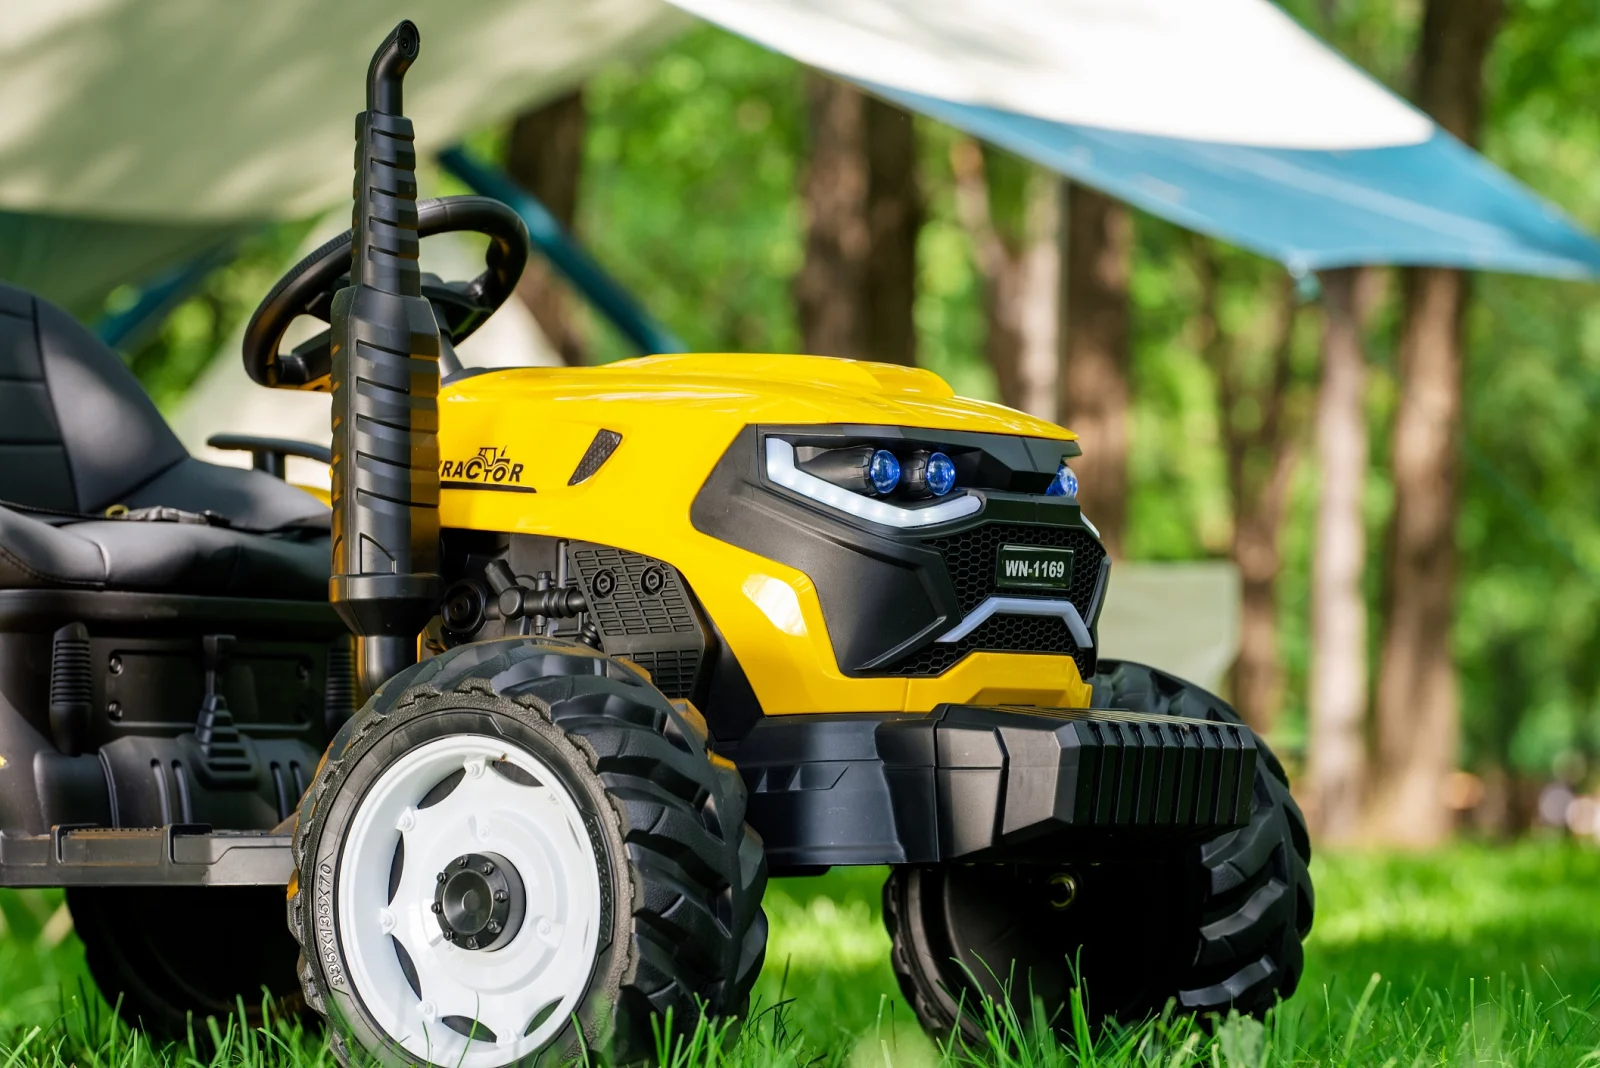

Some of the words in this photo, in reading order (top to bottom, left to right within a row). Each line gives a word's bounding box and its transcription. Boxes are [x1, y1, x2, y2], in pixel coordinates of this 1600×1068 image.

[439, 460, 524, 482] RACTOR
[1005, 559, 1065, 578] WN-1169
[318, 863, 345, 986] 335X135X70
